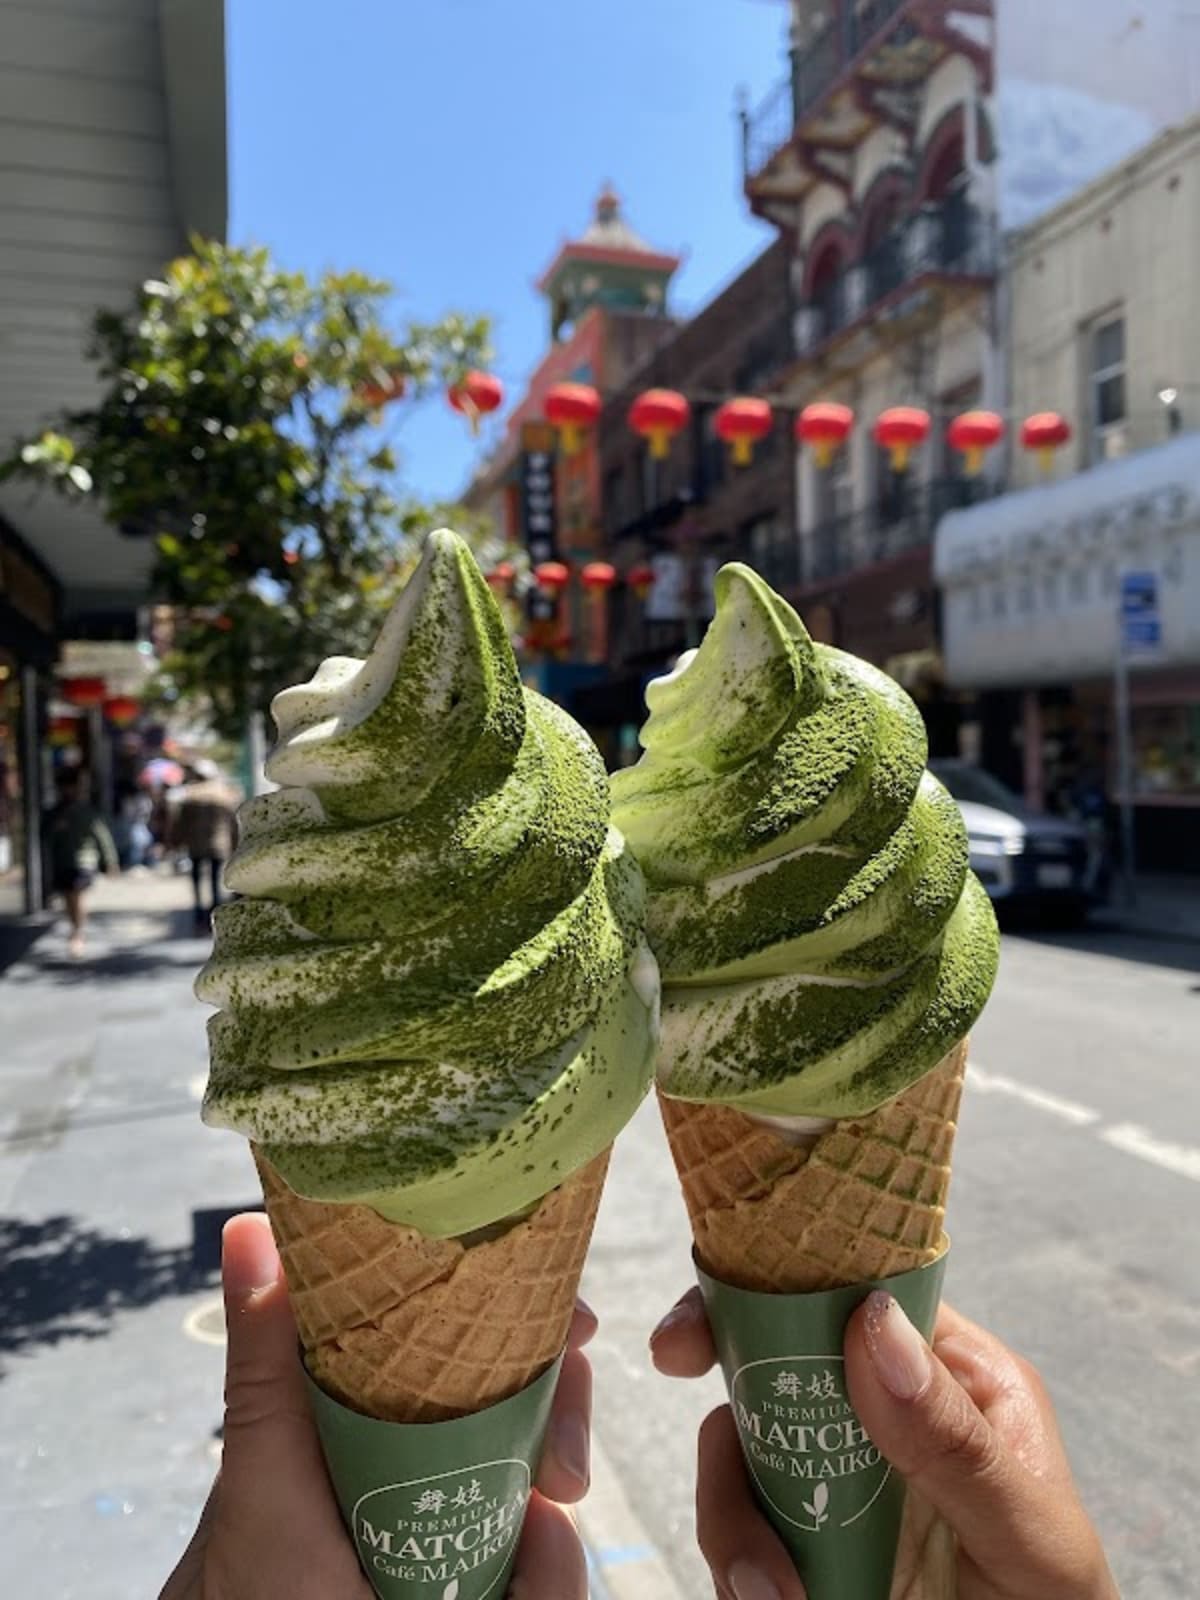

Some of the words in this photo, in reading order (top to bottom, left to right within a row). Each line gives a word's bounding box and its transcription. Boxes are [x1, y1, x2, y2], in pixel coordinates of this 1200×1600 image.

[771, 1369, 842, 1401] 舞妓
[738, 1401, 870, 1452] MATCH
[790, 1446, 882, 1479] MAIKO
[397, 1497, 498, 1533] PREMIUM
[412, 1479, 485, 1515] 舞妓
[361, 1490, 525, 1561] MATCHA
[373, 1555, 416, 1581] Café
[420, 1525, 513, 1583] MAIKO
